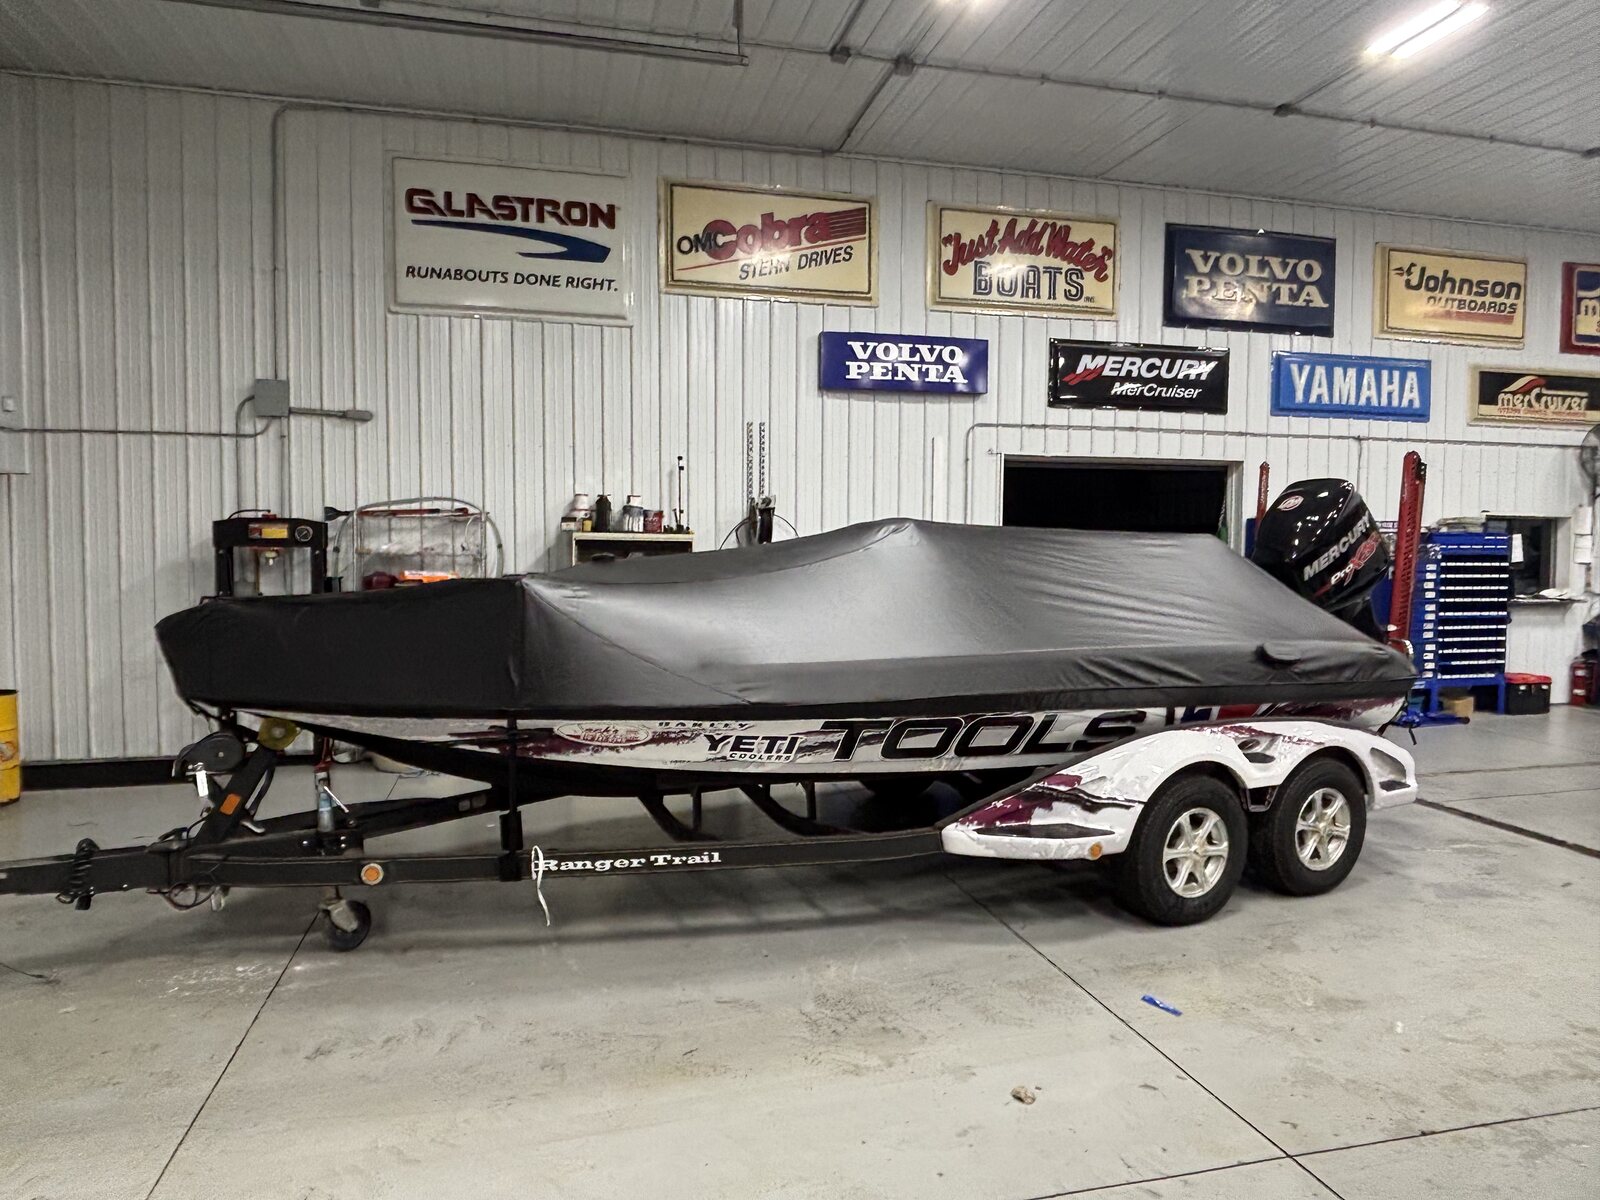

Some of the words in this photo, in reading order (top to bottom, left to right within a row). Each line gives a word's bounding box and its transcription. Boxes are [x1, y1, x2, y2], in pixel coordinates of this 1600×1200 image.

[405, 188, 616, 229] GLASTRON
[677, 231, 727, 255] OMC
[702, 211, 835, 260] Cobra
[998, 218, 1044, 256] Add
[797, 245, 854, 270] DRIVES
[1185, 249, 1322, 283] VOLVO
[405, 265, 508, 284] RUNABOUTS
[513, 272, 561, 288] DONE
[566, 276, 618, 292] RIGHT.
[973, 260, 1084, 302] BOATS
[1183, 275, 1329, 308] PENTA
[1404, 265, 1522, 301] Johnson
[1426, 295, 1518, 315] OUTBOARDS
[847, 341, 963, 364] VOLVO
[1074, 354, 1218, 381] MERCURY
[845, 361, 968, 384] PENTA
[1290, 363, 1420, 409] YAMAHA
[1111, 381, 1202, 399] MerCruiser
[1303, 510, 1370, 581] MERCURY
[704, 734, 800, 754] YETI
[820, 710, 1147, 762] TOOLS
[533, 857, 646, 872] Ranger
[650, 851, 722, 867] Trail
